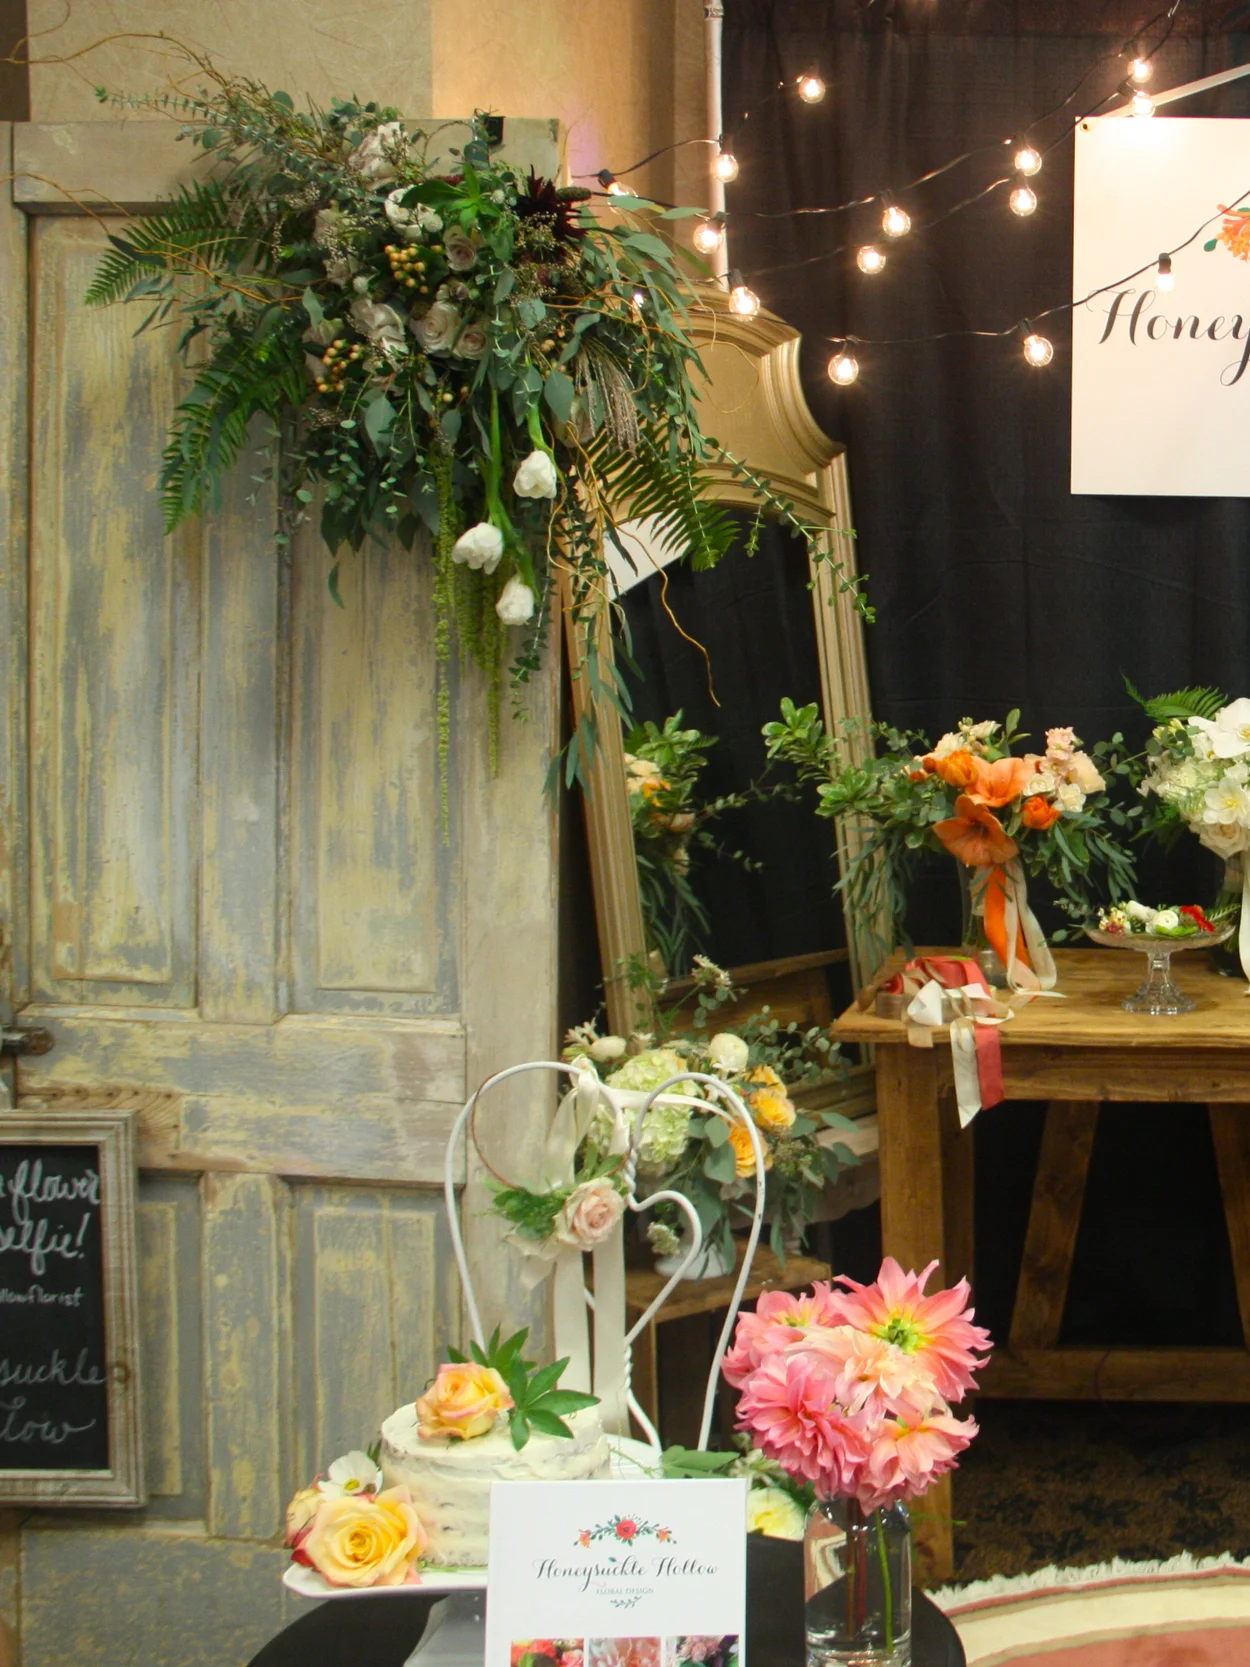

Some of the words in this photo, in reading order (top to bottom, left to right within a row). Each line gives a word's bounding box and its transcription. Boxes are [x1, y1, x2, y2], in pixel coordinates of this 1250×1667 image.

[531, 1555, 648, 1593] Honeysuckle
[652, 1555, 719, 1578] Hollow
[596, 1587, 623, 1595] FLORAL
[626, 1586, 655, 1595] DESIGN
